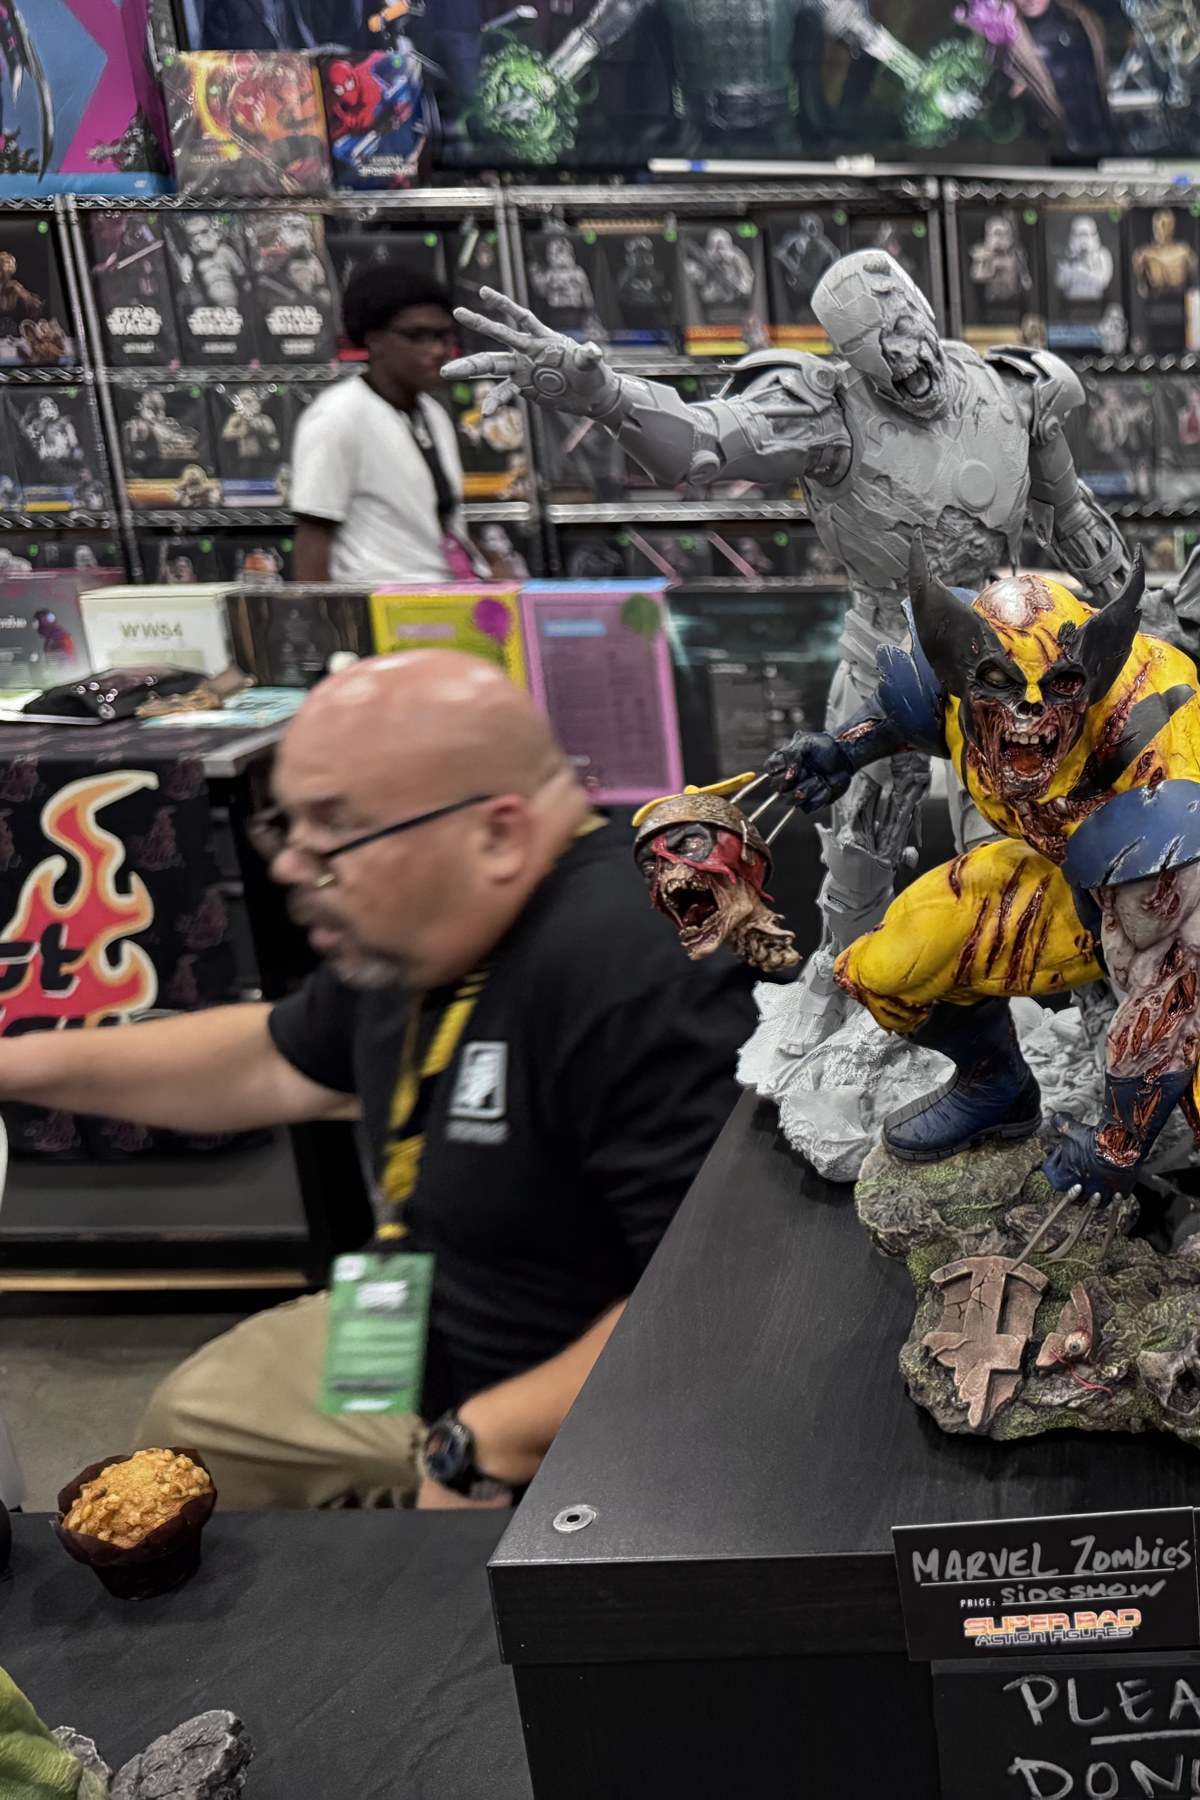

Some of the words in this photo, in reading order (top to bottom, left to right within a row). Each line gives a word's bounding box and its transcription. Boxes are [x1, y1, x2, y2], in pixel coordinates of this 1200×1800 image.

[912, 1542, 1059, 1582] MARVEL
[1071, 1535, 1192, 1575] Zombies
[960, 1598, 997, 1609] PRICE:
[963, 1612, 1070, 1638] SUPER
[1074, 1608, 1142, 1629] BAD
[975, 1630, 1047, 1647] ACTION
[1050, 1626, 1134, 1643] FIGURES
